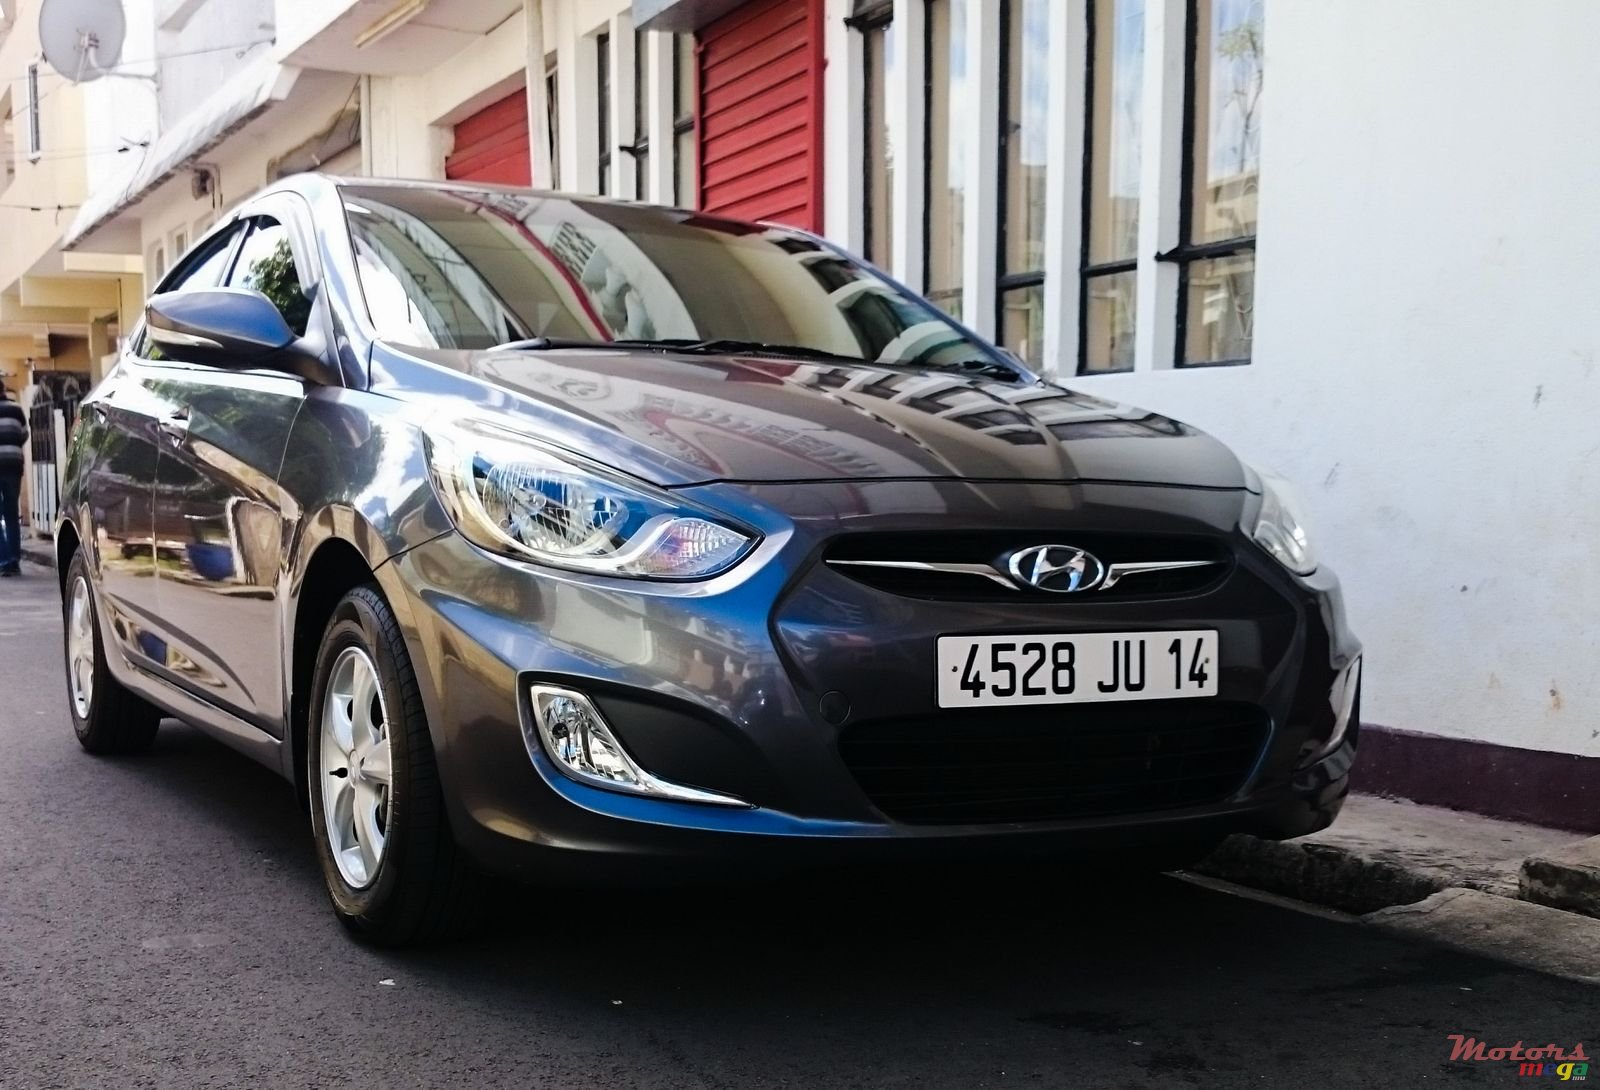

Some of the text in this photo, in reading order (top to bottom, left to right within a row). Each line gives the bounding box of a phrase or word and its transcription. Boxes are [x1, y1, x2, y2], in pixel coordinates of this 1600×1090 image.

[960, 637, 1208, 698] 4528 JU 14
